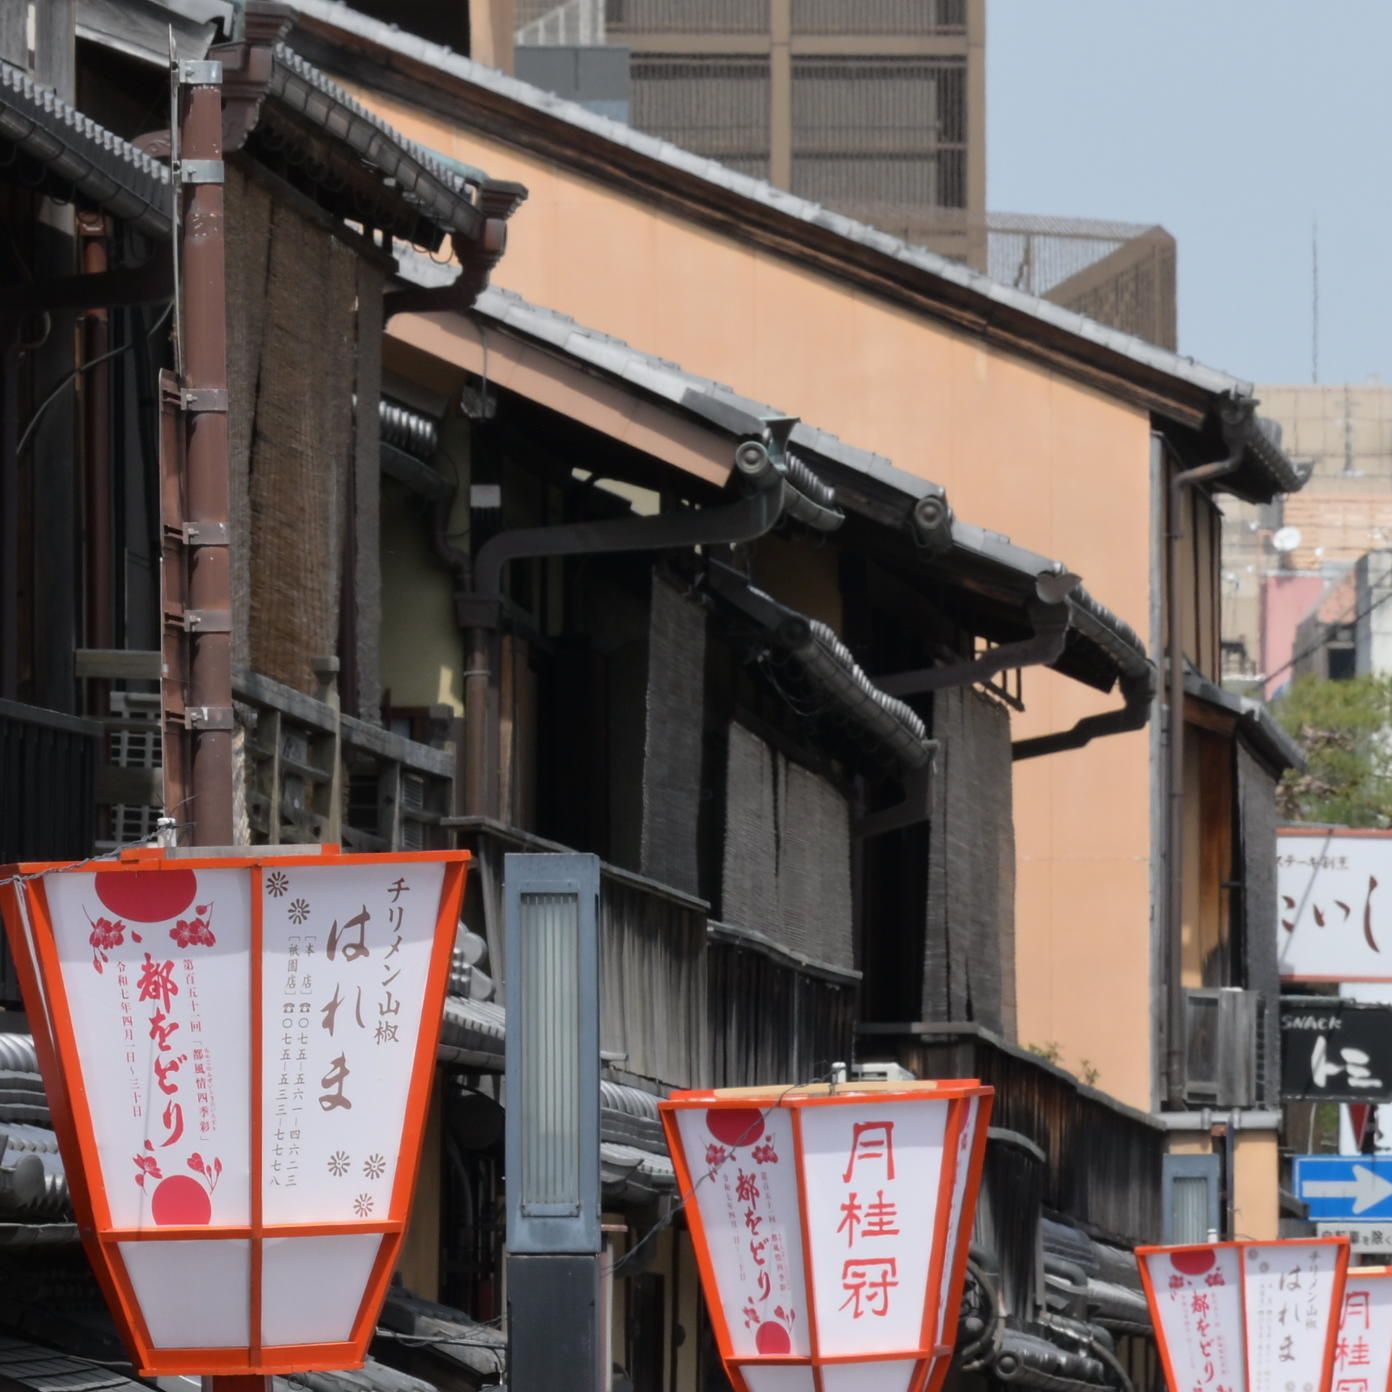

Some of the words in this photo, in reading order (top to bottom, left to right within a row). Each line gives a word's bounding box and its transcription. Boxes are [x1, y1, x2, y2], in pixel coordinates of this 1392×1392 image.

[373, 877, 410, 1045] チリメン山椒
[1282, 875, 1380, 953] こいし
[136, 952, 188, 1148] 都をどり
[318, 904, 372, 1112] はれま
[1281, 1015, 1342, 1030] SNACK
[1311, 1035, 1383, 1088] トミ
[736, 1168, 771, 1301] 都をどり
[836, 1120, 901, 1319] 月桂冠
[1191, 1289, 1215, 1383] 都をどり
[1278, 1265, 1302, 1362] はれま
